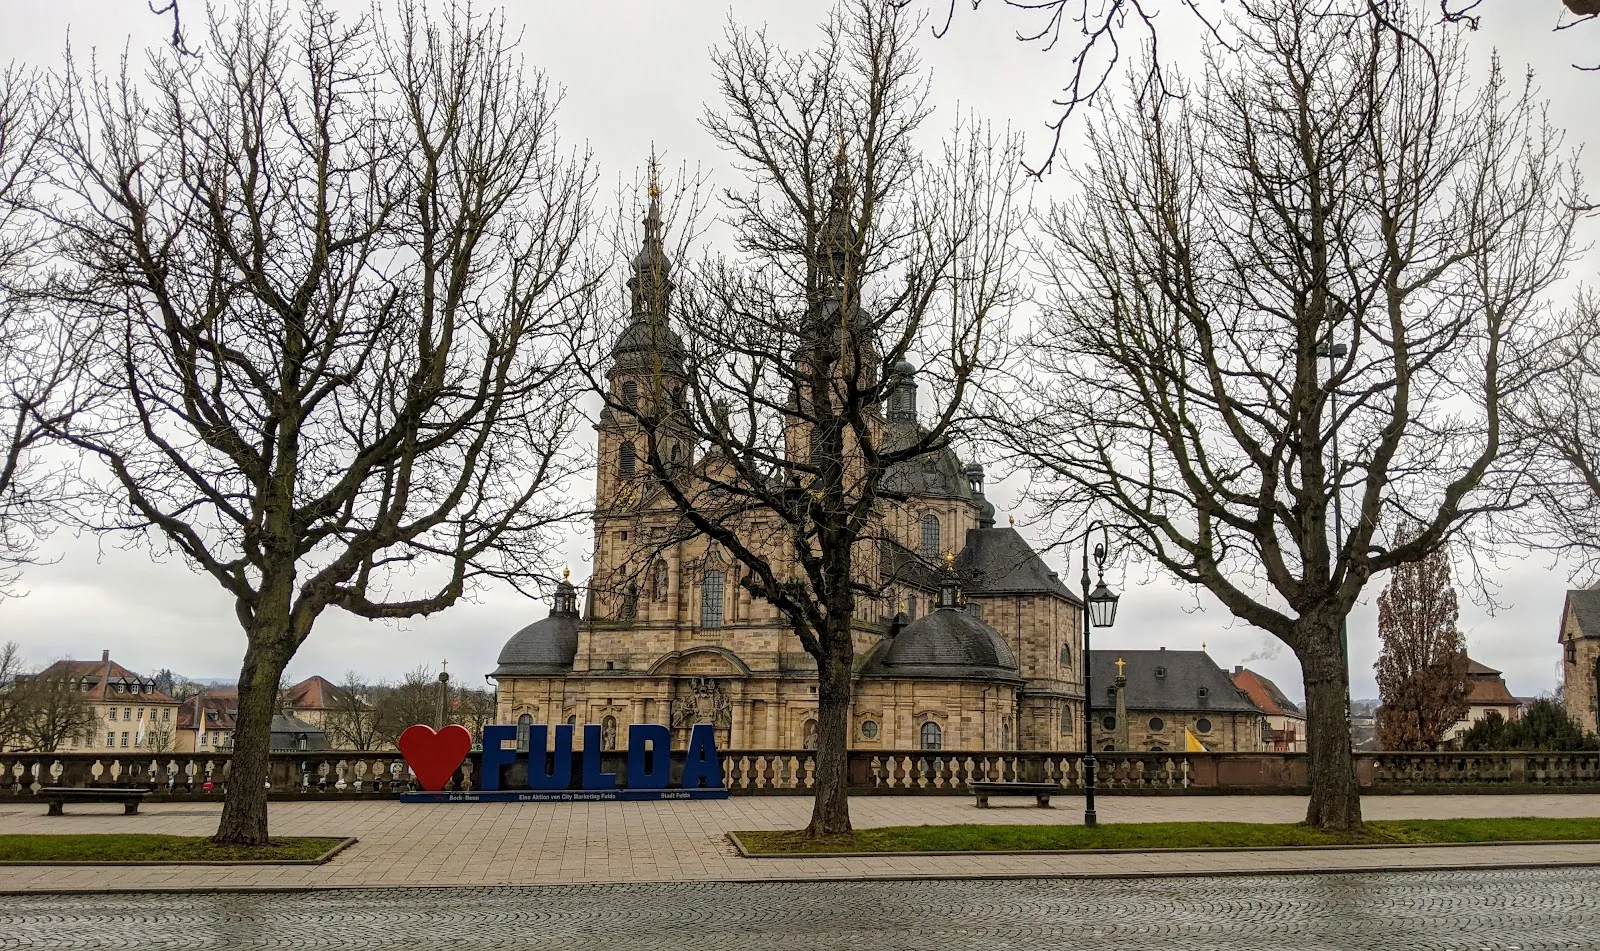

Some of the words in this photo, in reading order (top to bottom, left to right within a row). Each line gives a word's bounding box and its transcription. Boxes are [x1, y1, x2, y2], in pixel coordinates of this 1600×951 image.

[481, 724, 726, 790] FULDA
[561, 793, 572, 801] City
[573, 793, 600, 801] Marketing
[601, 792, 616, 800] Fulda
